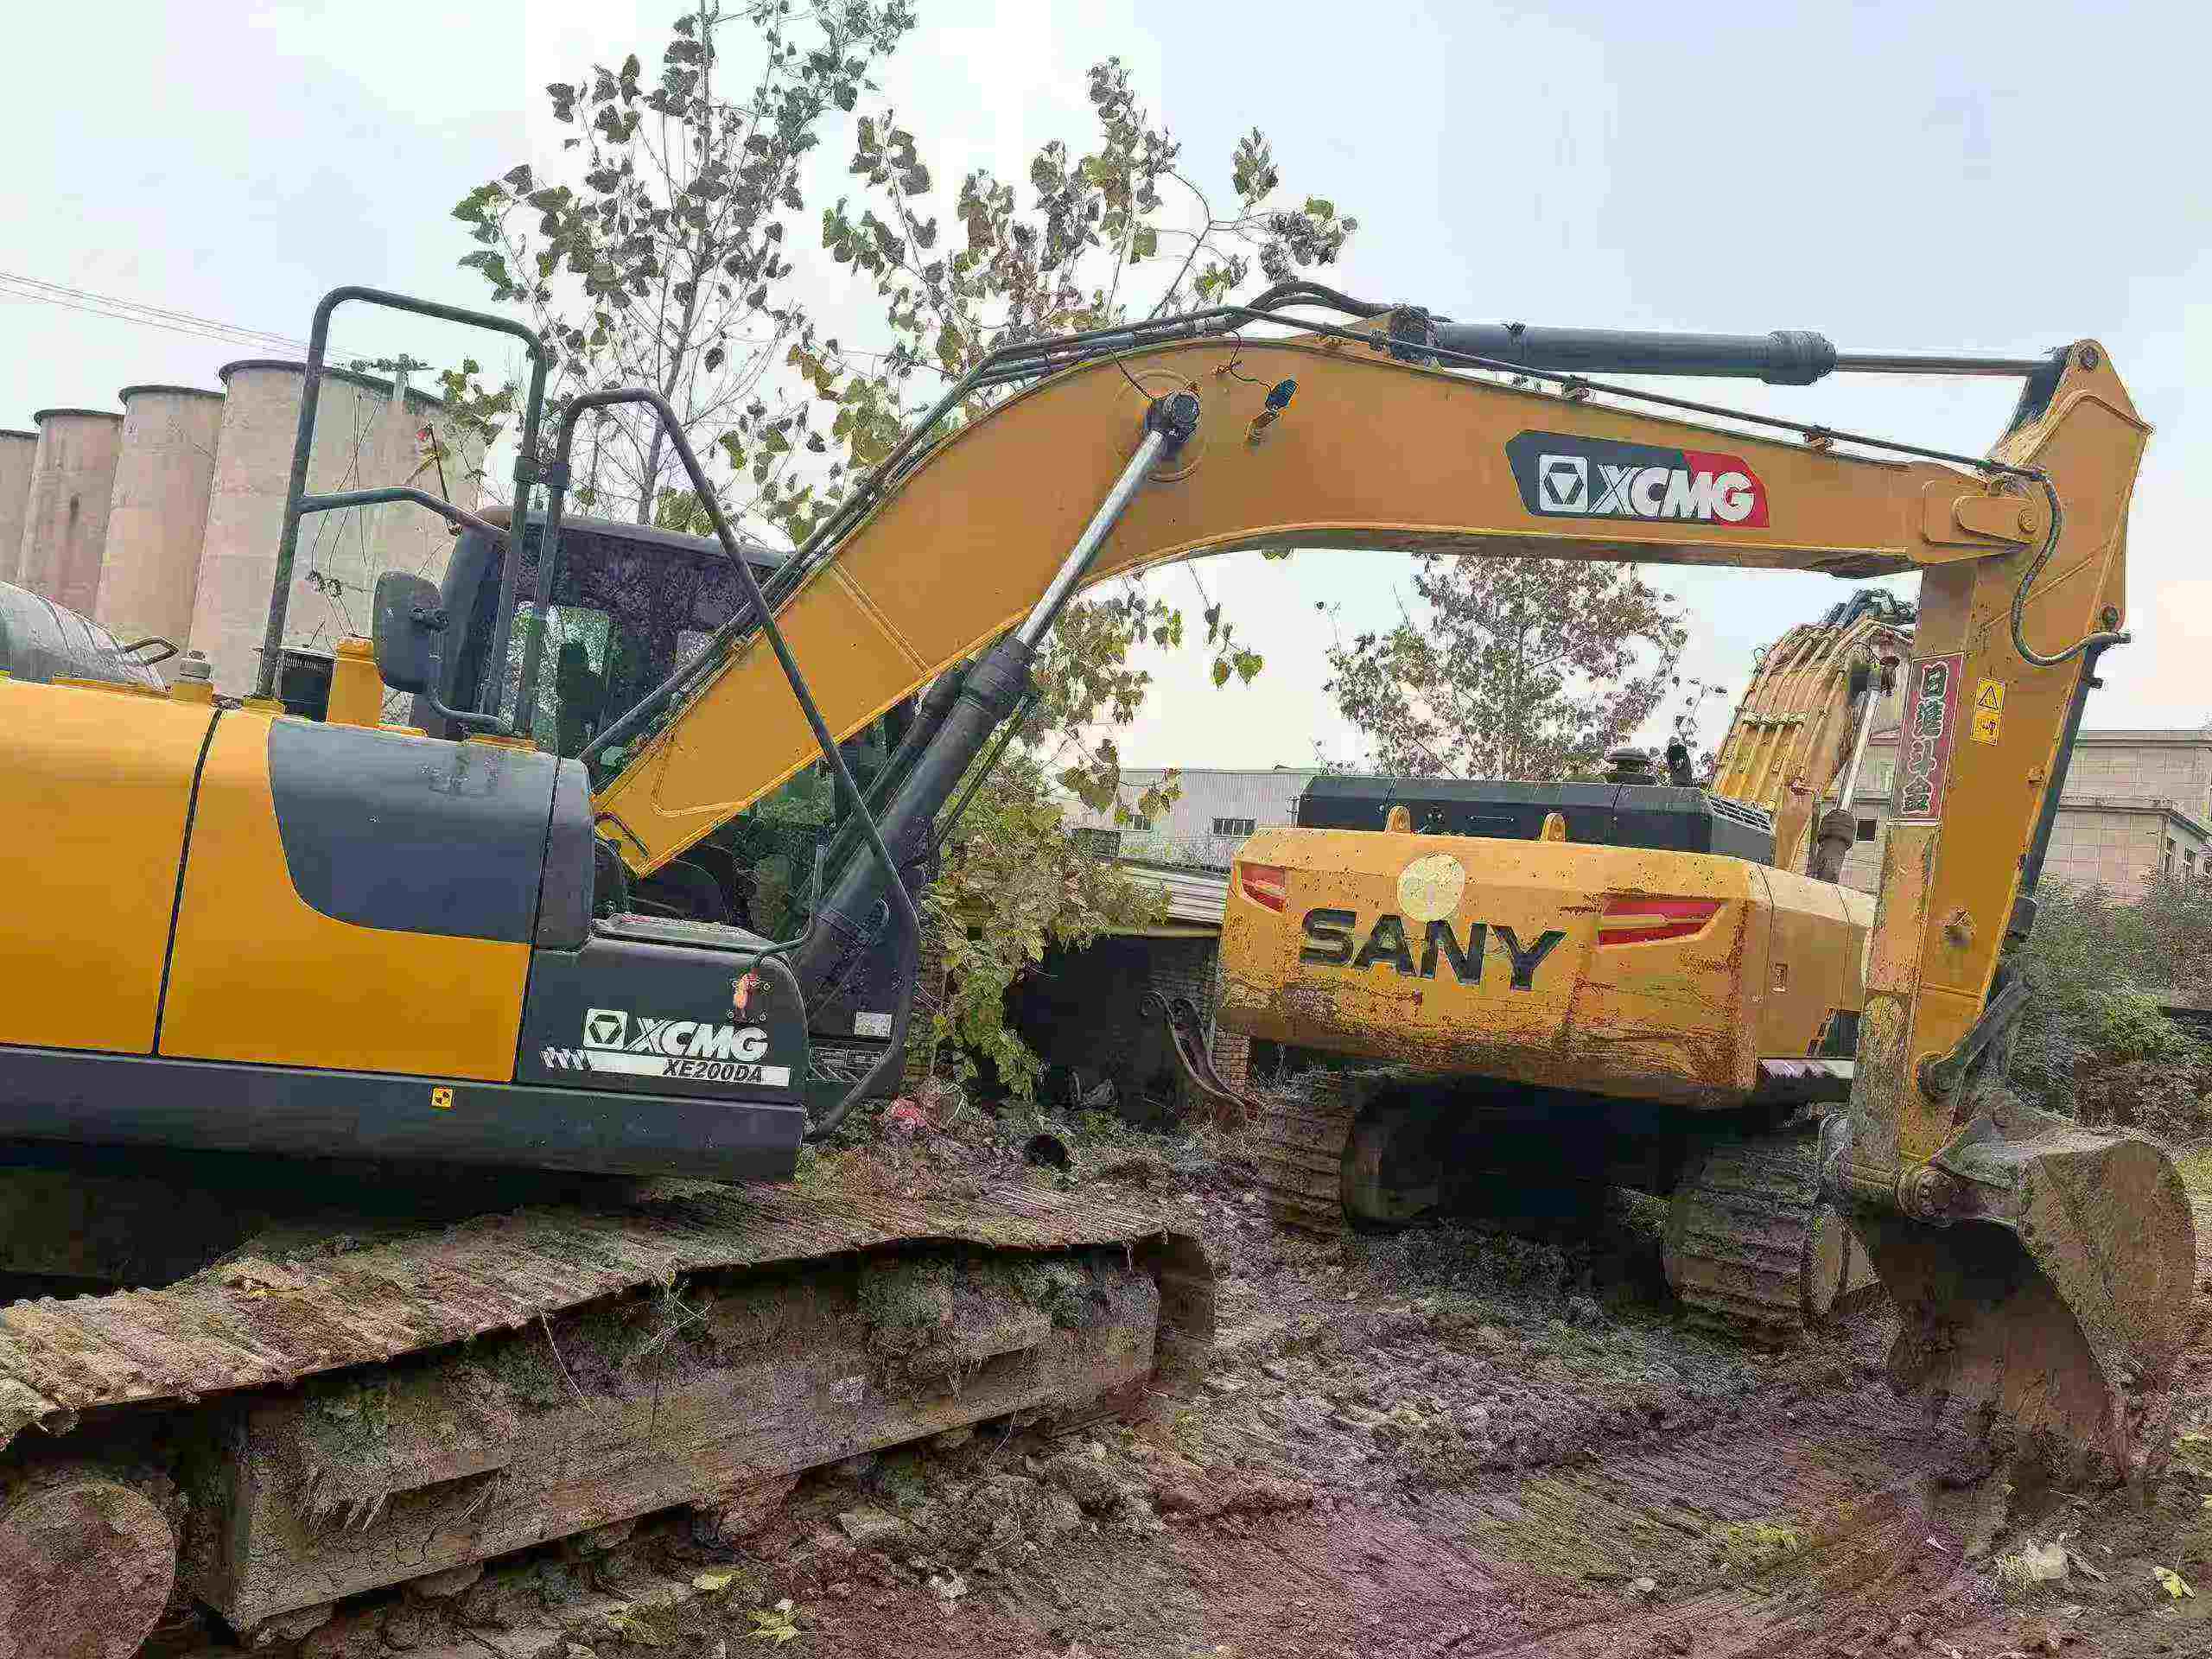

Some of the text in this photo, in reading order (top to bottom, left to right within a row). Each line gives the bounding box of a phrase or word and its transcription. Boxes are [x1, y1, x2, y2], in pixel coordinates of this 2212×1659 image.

[1589, 464, 1755, 521] XCMG
[1300, 908, 1567, 991] SANY
[625, 1017, 768, 1061] XCMG
[662, 1058, 762, 1081] XE200DA
